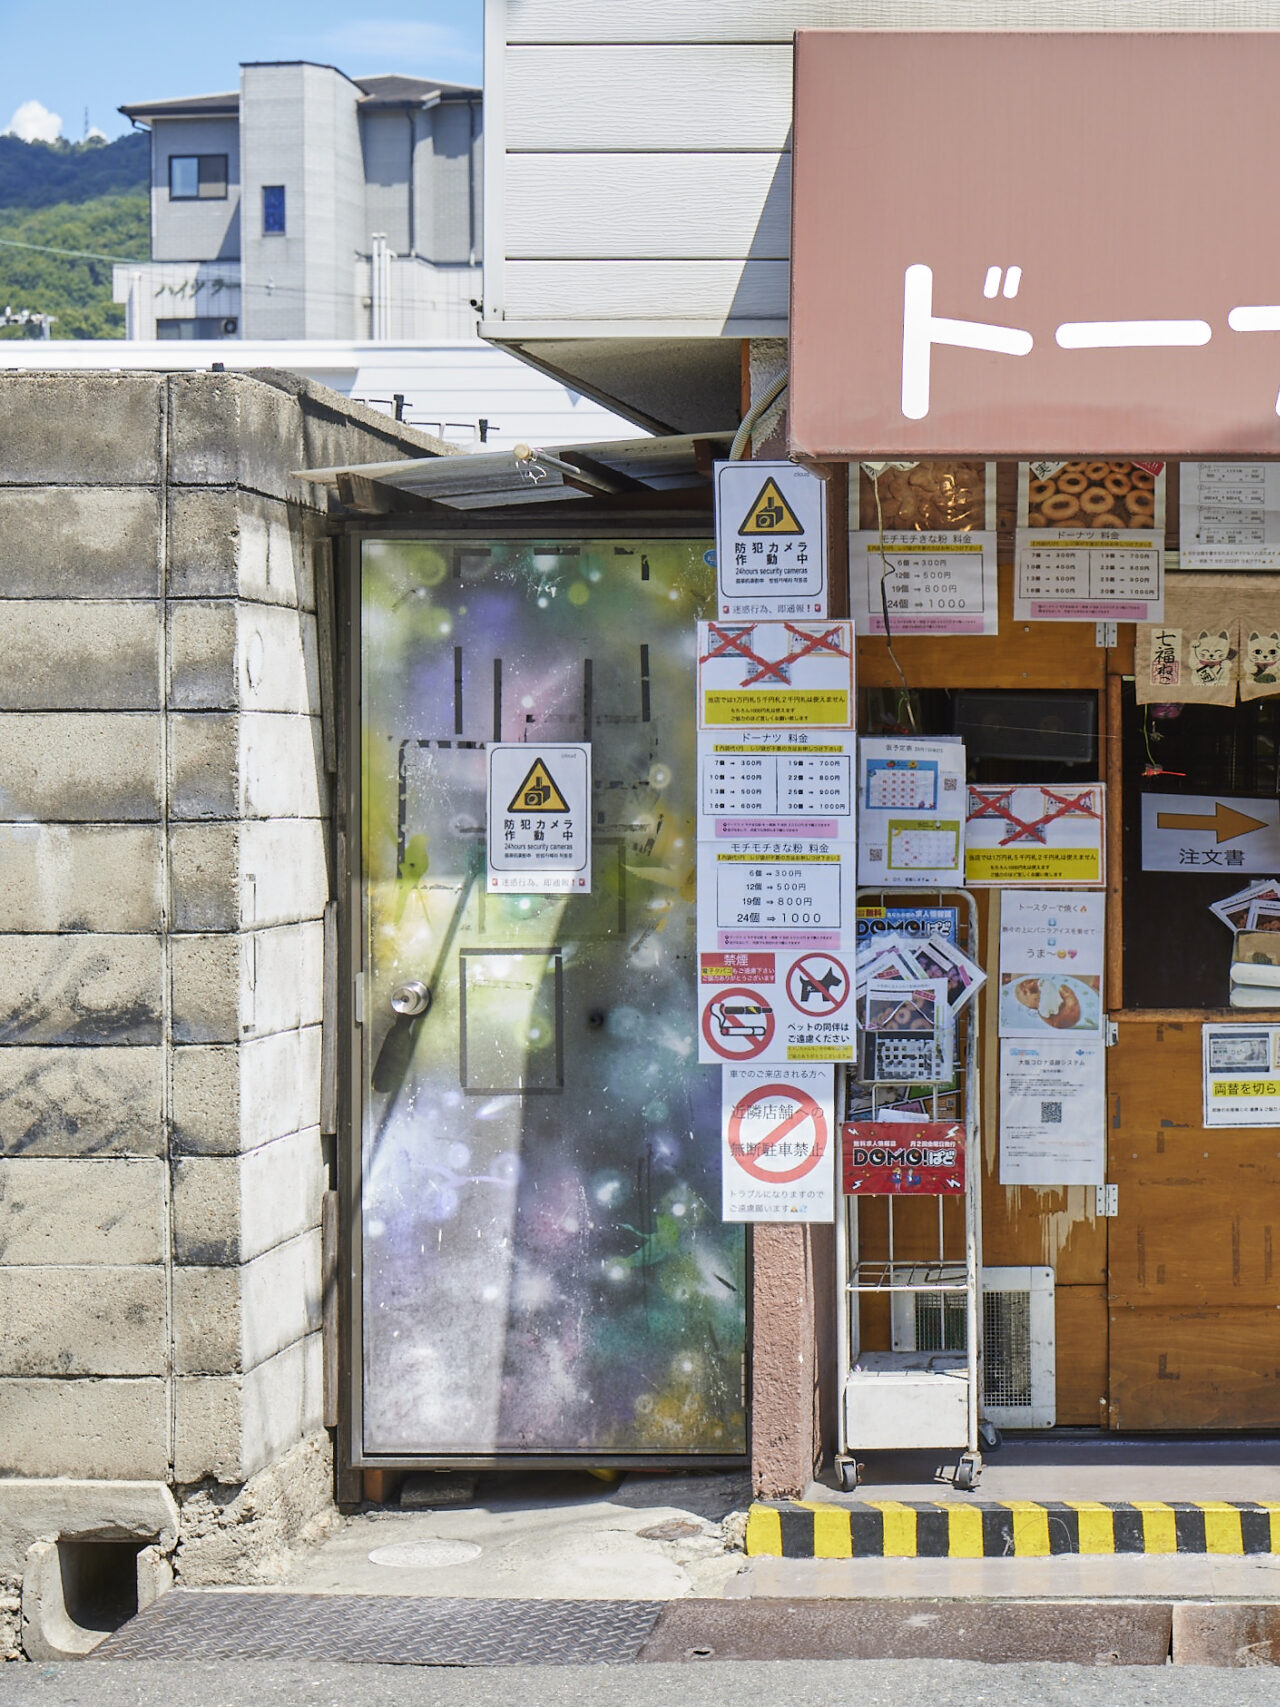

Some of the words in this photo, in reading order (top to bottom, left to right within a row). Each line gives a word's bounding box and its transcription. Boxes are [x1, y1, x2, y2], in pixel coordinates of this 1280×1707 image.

[952, 534, 973, 543] 料金
[1057, 531, 1095, 540] ドーナツ
[1100, 531, 1120, 540] 料金
[734, 542, 808, 554] 防犯カメラ
[735, 554, 809, 566] 作動中
[735, 567, 759, 576] 24hours
[759, 567, 783, 577] security
[783, 567, 808, 575] cameras
[742, 733, 782, 744] ドーナツ
[787, 733, 809, 744] 料金
[504, 819, 574, 831] 防犯カメラ
[504, 831, 574, 841] 作動中
[504, 843, 526, 851] 24hours
[527, 843, 549, 852] security
[550, 843, 573, 851] cameras
[730, 843, 803, 854] モチモチきな粉
[808, 843, 830, 854] 料金
[1178, 848, 1246, 867] 注文書
[749, 869, 762, 878] 6個
[775, 869, 802, 878] 300円
[746, 883, 762, 891] 12個
[776, 883, 806, 892] 500円
[742, 896, 761, 906] 19個
[777, 896, 812, 907] 800円
[736, 912, 761, 924] 24個
[781, 912, 822, 924] 1000
[723, 954, 750, 966] 禁煙
[787, 1023, 850, 1032] ペットの同伴は
[787, 1034, 851, 1043] ご遠慮ください
[729, 1070, 827, 1079] 車でのご来店される方へ
[731, 1103, 825, 1120] 近隣店舗への
[730, 1141, 825, 1158] 無断駐車禁止
[729, 1189, 825, 1200] トラブルになりますので
